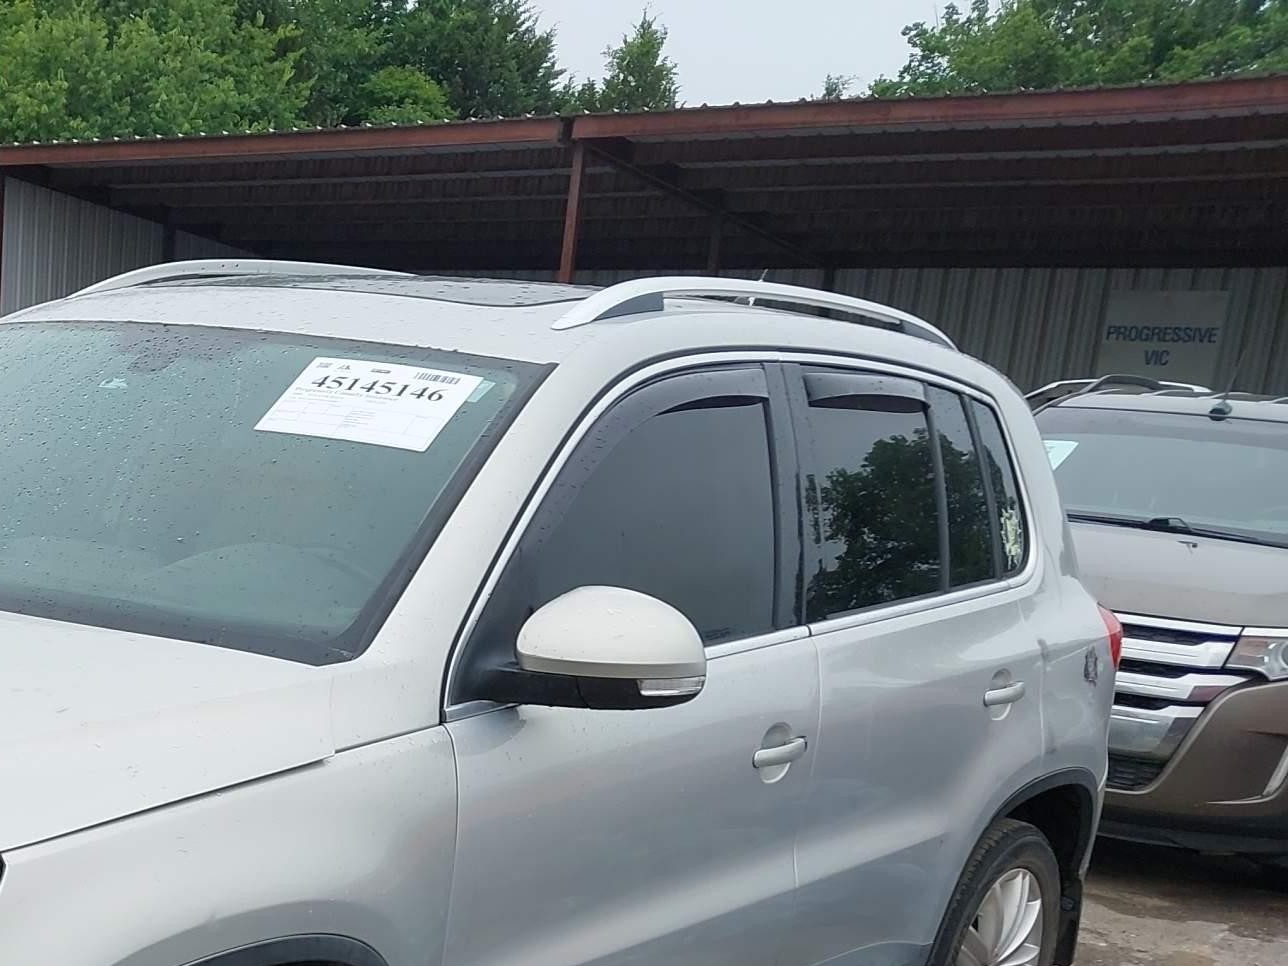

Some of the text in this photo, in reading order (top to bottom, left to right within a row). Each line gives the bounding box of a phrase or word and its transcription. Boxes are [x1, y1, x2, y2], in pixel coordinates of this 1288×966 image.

[1105, 325, 1220, 343] PROGRESSIVE
[1143, 350, 1170, 366] VIC
[312, 375, 450, 402] 45145146
